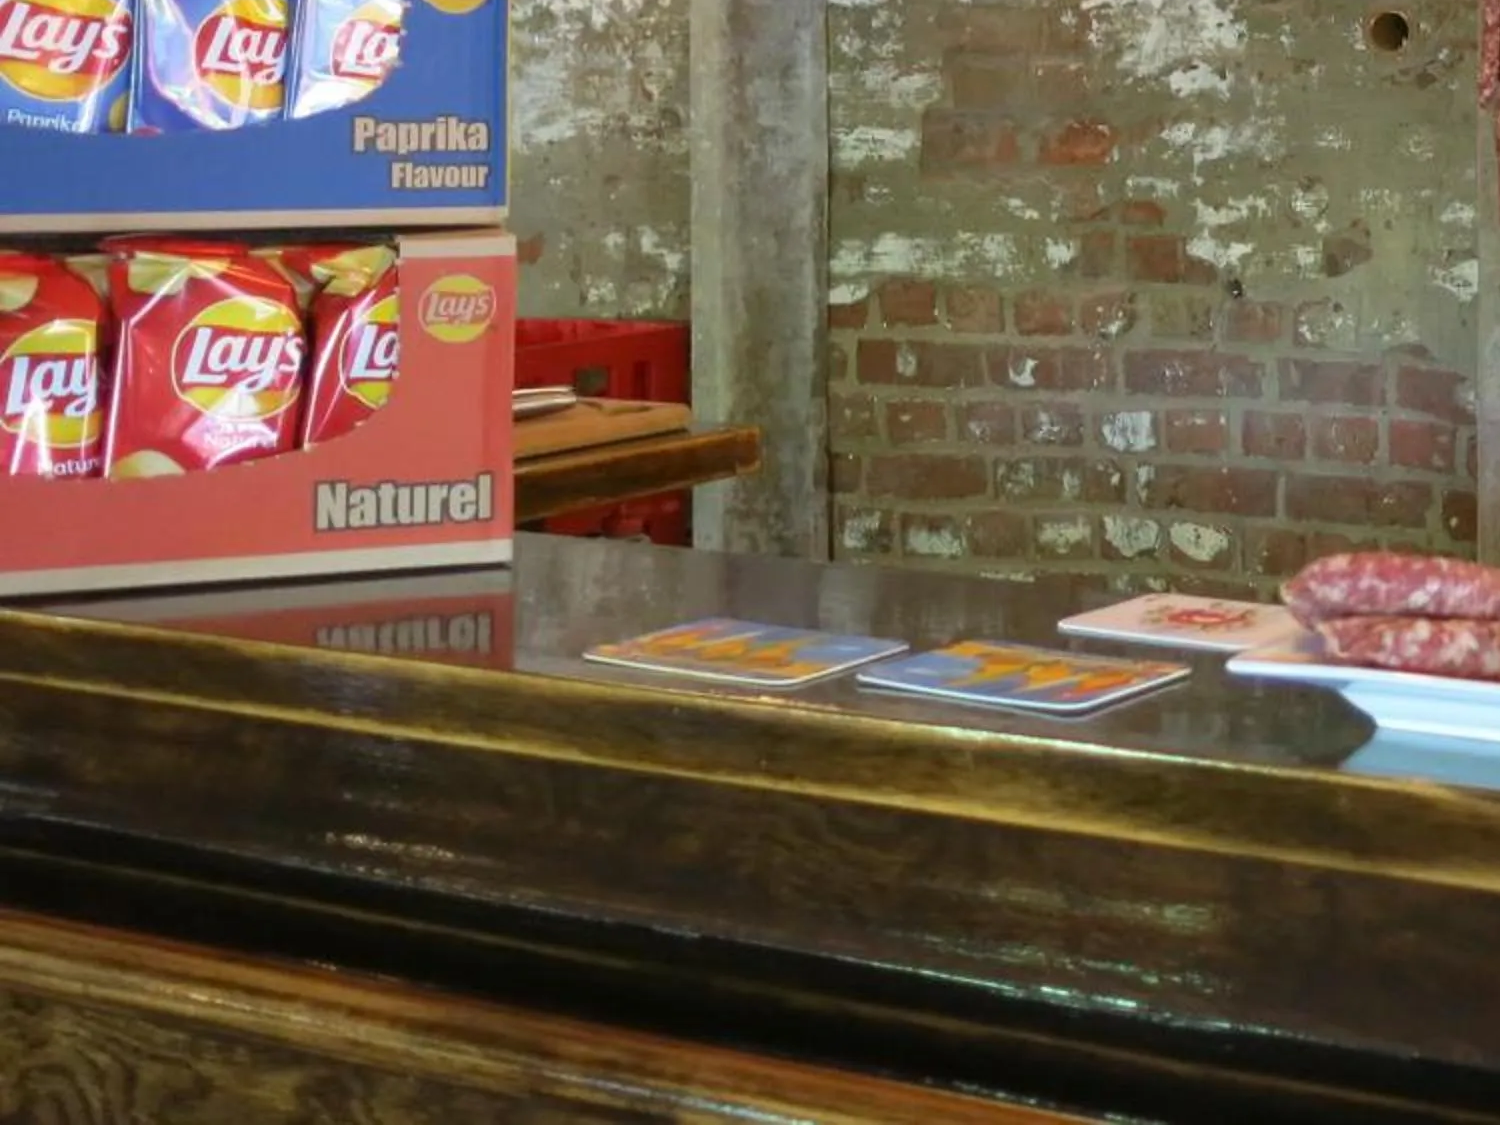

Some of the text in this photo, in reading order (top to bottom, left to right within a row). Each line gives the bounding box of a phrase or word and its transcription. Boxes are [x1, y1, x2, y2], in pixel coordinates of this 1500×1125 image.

[352, 116, 489, 155] Paprika
[390, 161, 489, 190] Flavour
[314, 473, 493, 533] Naturel
